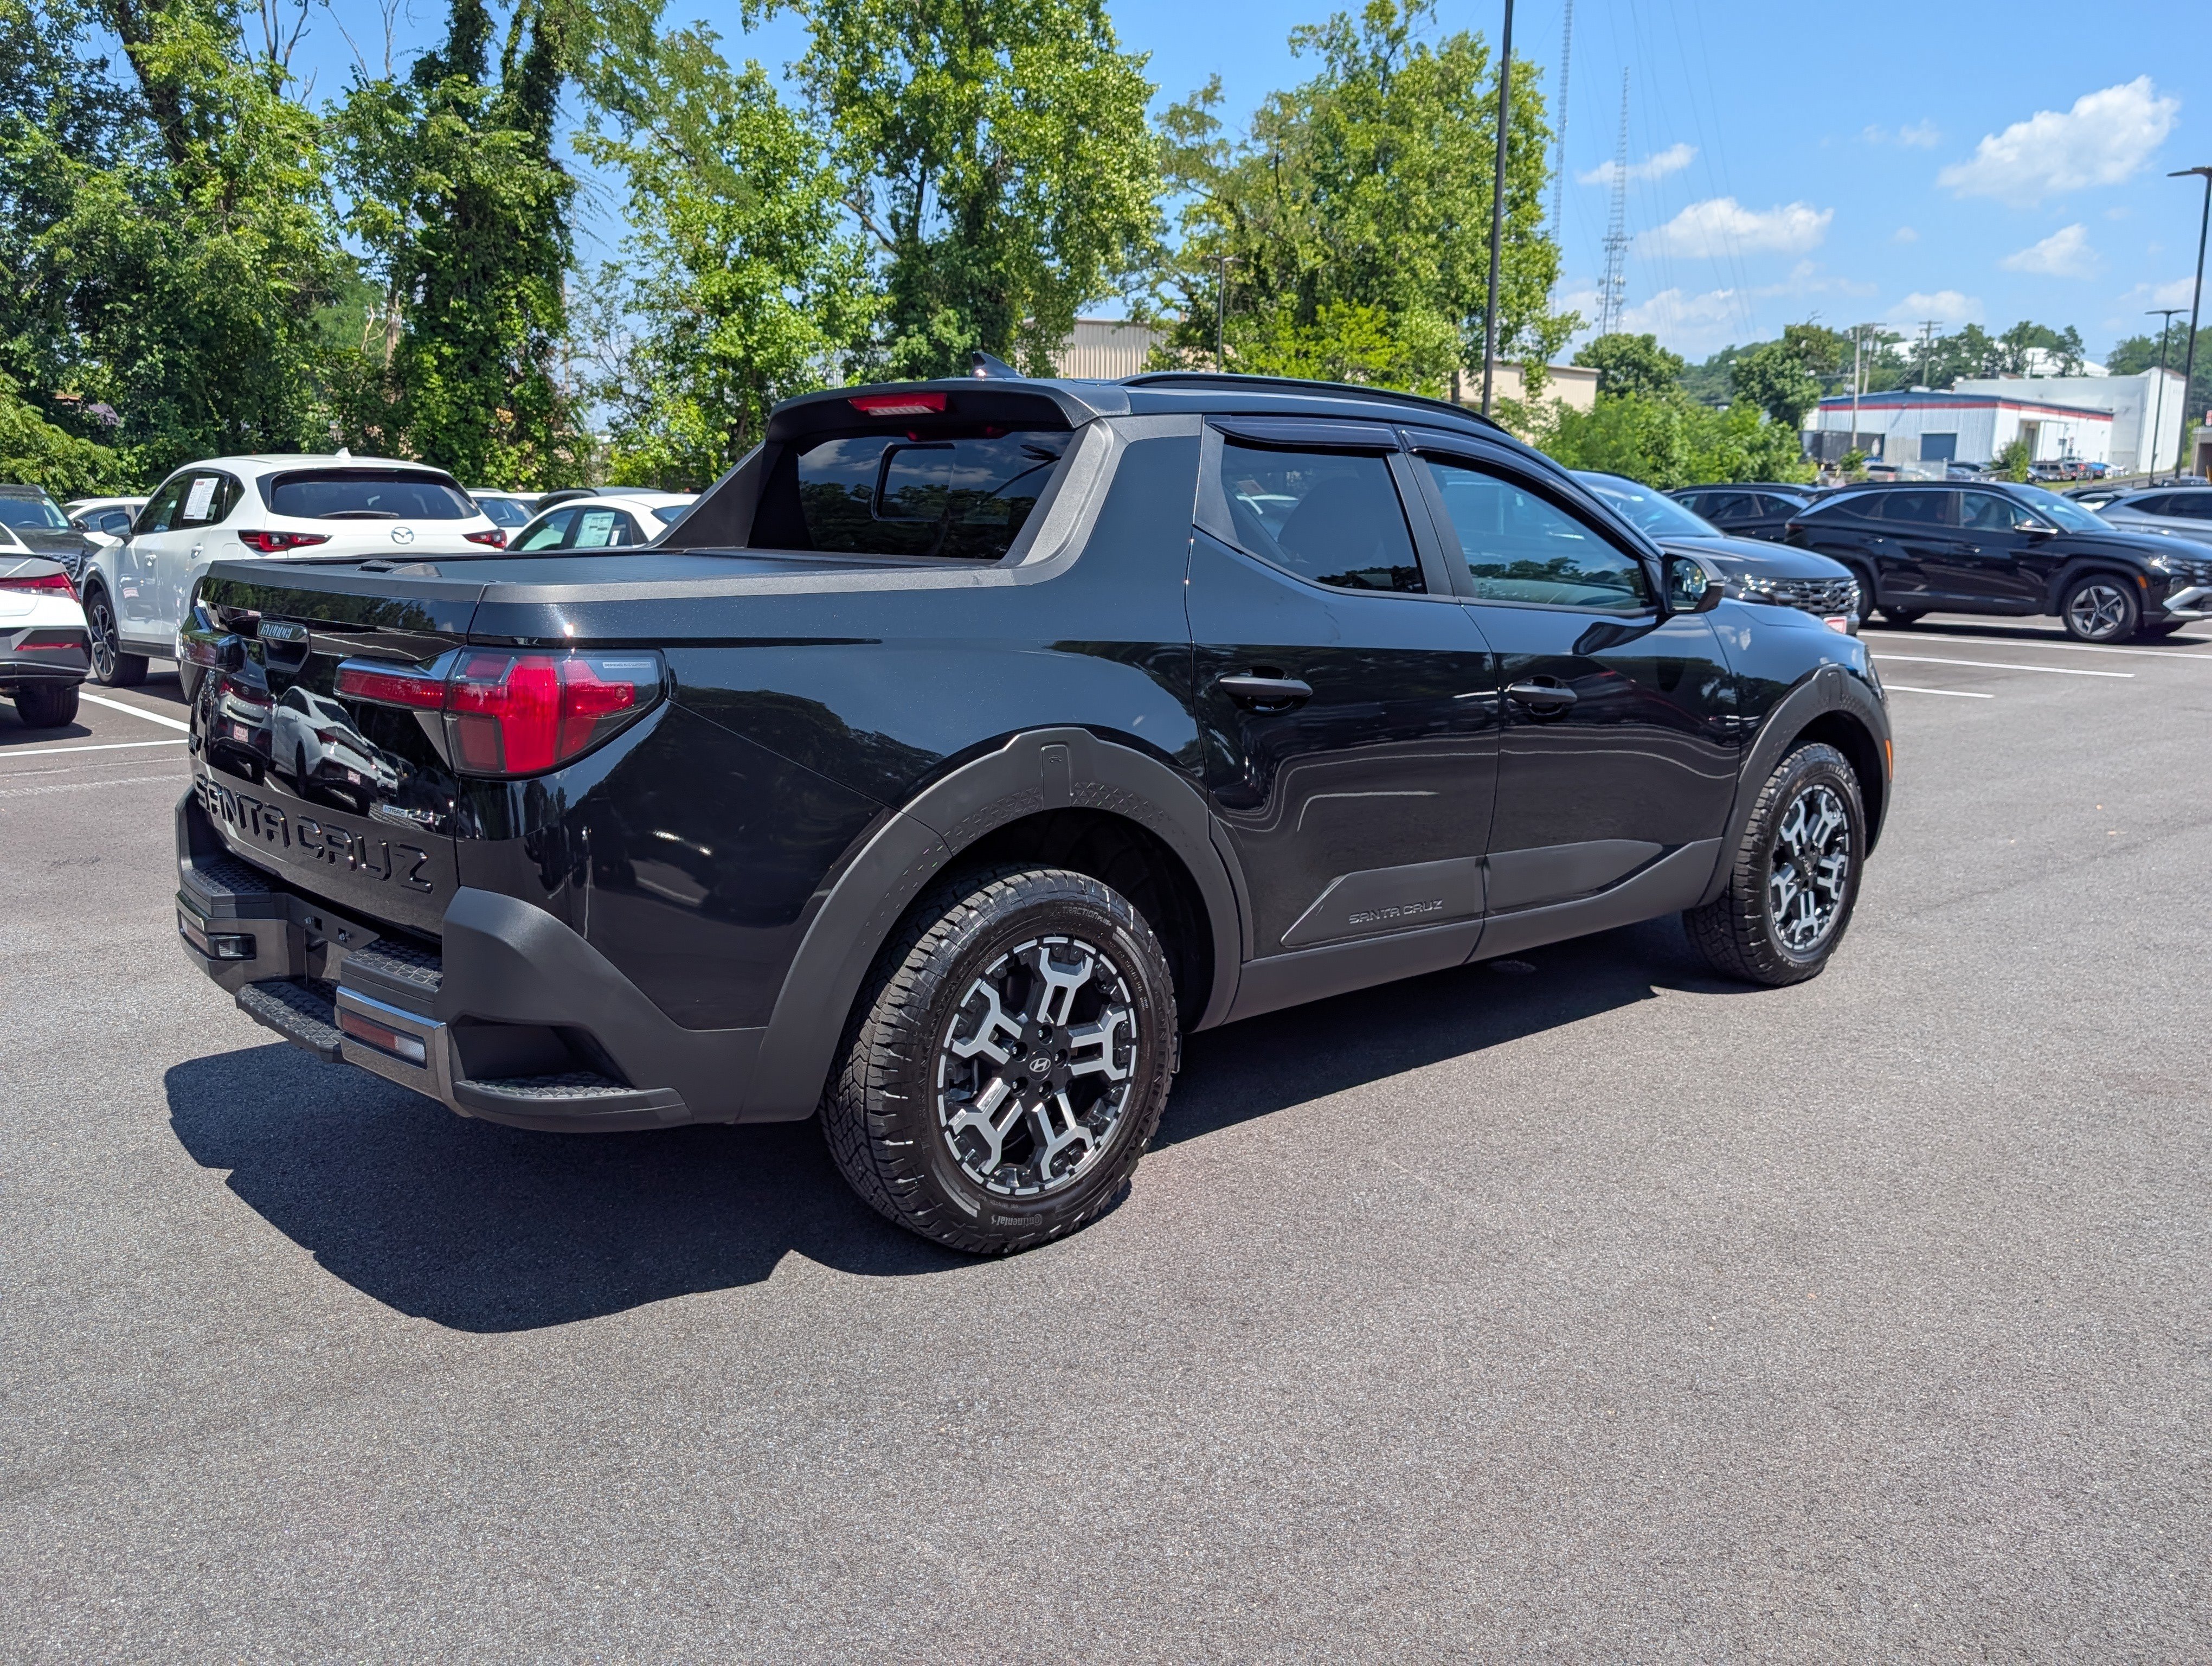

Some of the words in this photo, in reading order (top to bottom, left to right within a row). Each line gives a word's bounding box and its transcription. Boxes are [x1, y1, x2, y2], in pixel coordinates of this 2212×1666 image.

[194, 771, 291, 848] SANTA
[297, 815, 433, 894] CRUZ
[1348, 906, 1400, 924] SANTA
[1403, 899, 1443, 915] CRUZ
